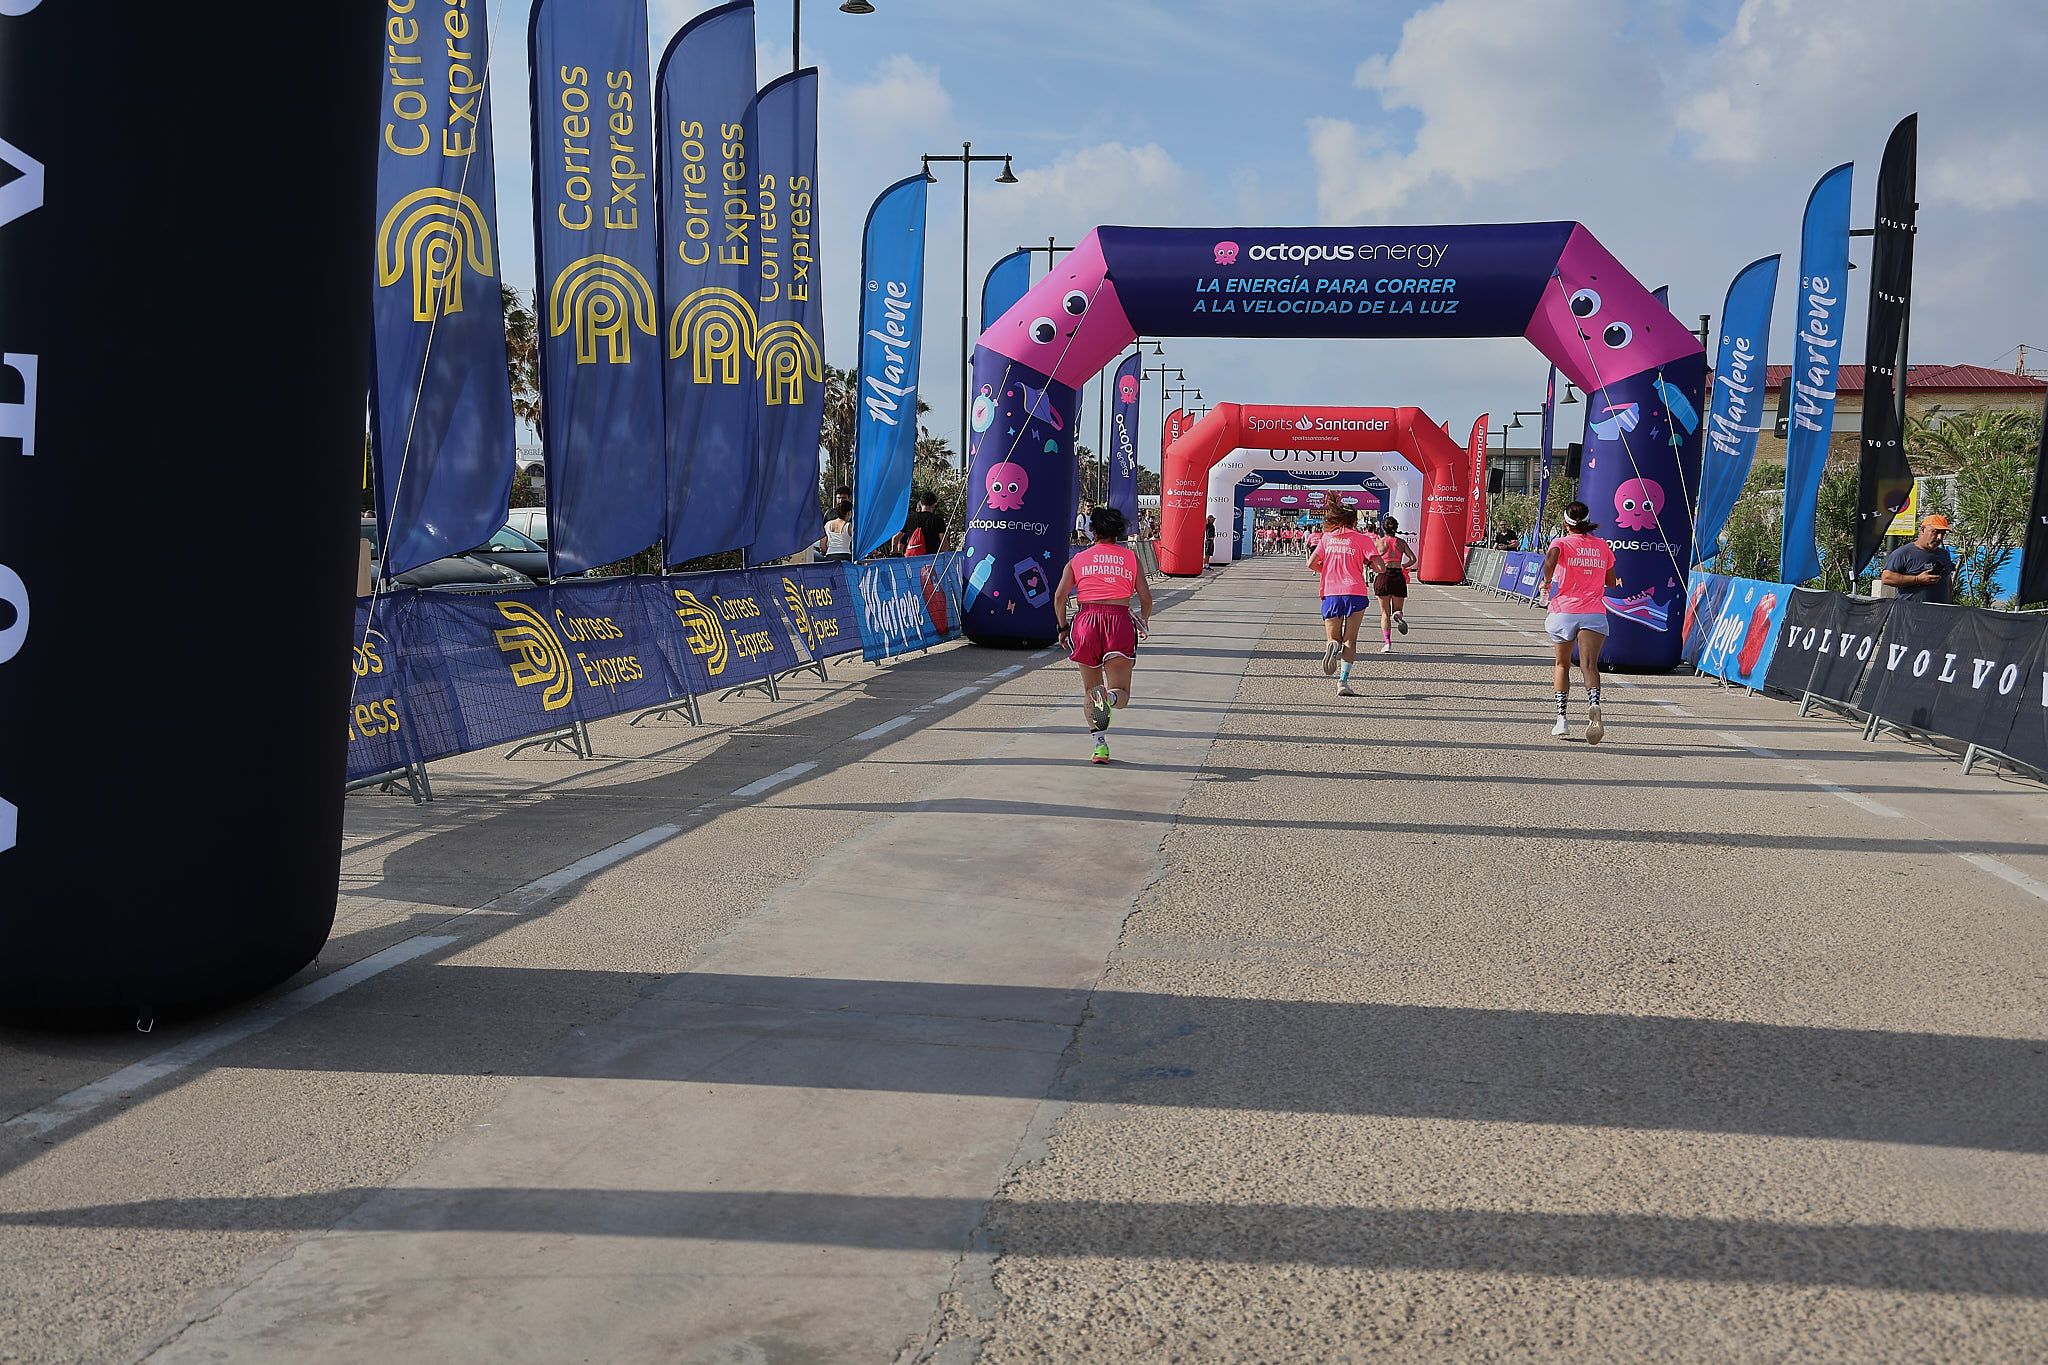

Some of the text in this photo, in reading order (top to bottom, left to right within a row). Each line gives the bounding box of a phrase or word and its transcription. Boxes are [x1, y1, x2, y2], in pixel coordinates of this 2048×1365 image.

[384, 0, 430, 156] Corre
[442, 0, 482, 157] Expre
[558, 65, 594, 231] Correos
[604, 70, 646, 230] Express
[679, 120, 710, 265] Correos
[719, 123, 756, 266] Express
[787, 175, 814, 301] Express
[1248, 243, 1448, 268] octopus energy
[1195, 275, 1457, 294] LA ENERGÍA PARA CORRER
[1193, 299, 1460, 314] A LA VELOCIDAD DE LA LUZ
[865, 281, 916, 426] Marlene
[1794, 276, 1837, 432] Marlene
[1710, 337, 1760, 456] Marlene
[1115, 413, 1136, 470] octopus
[1248, 416, 1390, 433] Sports Santander
[1116, 451, 1129, 478] energy
[1269, 450, 1358, 463] OYSHO
[1474, 423, 1484, 485] Santander
[1173, 488, 1204, 496] Santander
[1175, 479, 1196, 488] Sports
[1434, 495, 1465, 503] Santander
[1437, 484, 1458, 493] Sports
[969, 518, 1049, 536] octopus energy
[1471, 502, 1482, 539] Sports
[1093, 554, 1125, 565] SOMOS
[1576, 547, 1601, 558] SOMOS
[1603, 539, 1682, 557] opus energy
[1081, 566, 1133, 581] IMPARABLES
[555, 608, 624, 643] Correos
[711, 595, 761, 621] Correos
[730, 628, 775, 663] Express
[1787, 625, 1873, 661] VOLVO
[576, 652, 644, 694] Express
[1886, 643, 2018, 695] VOLVO
